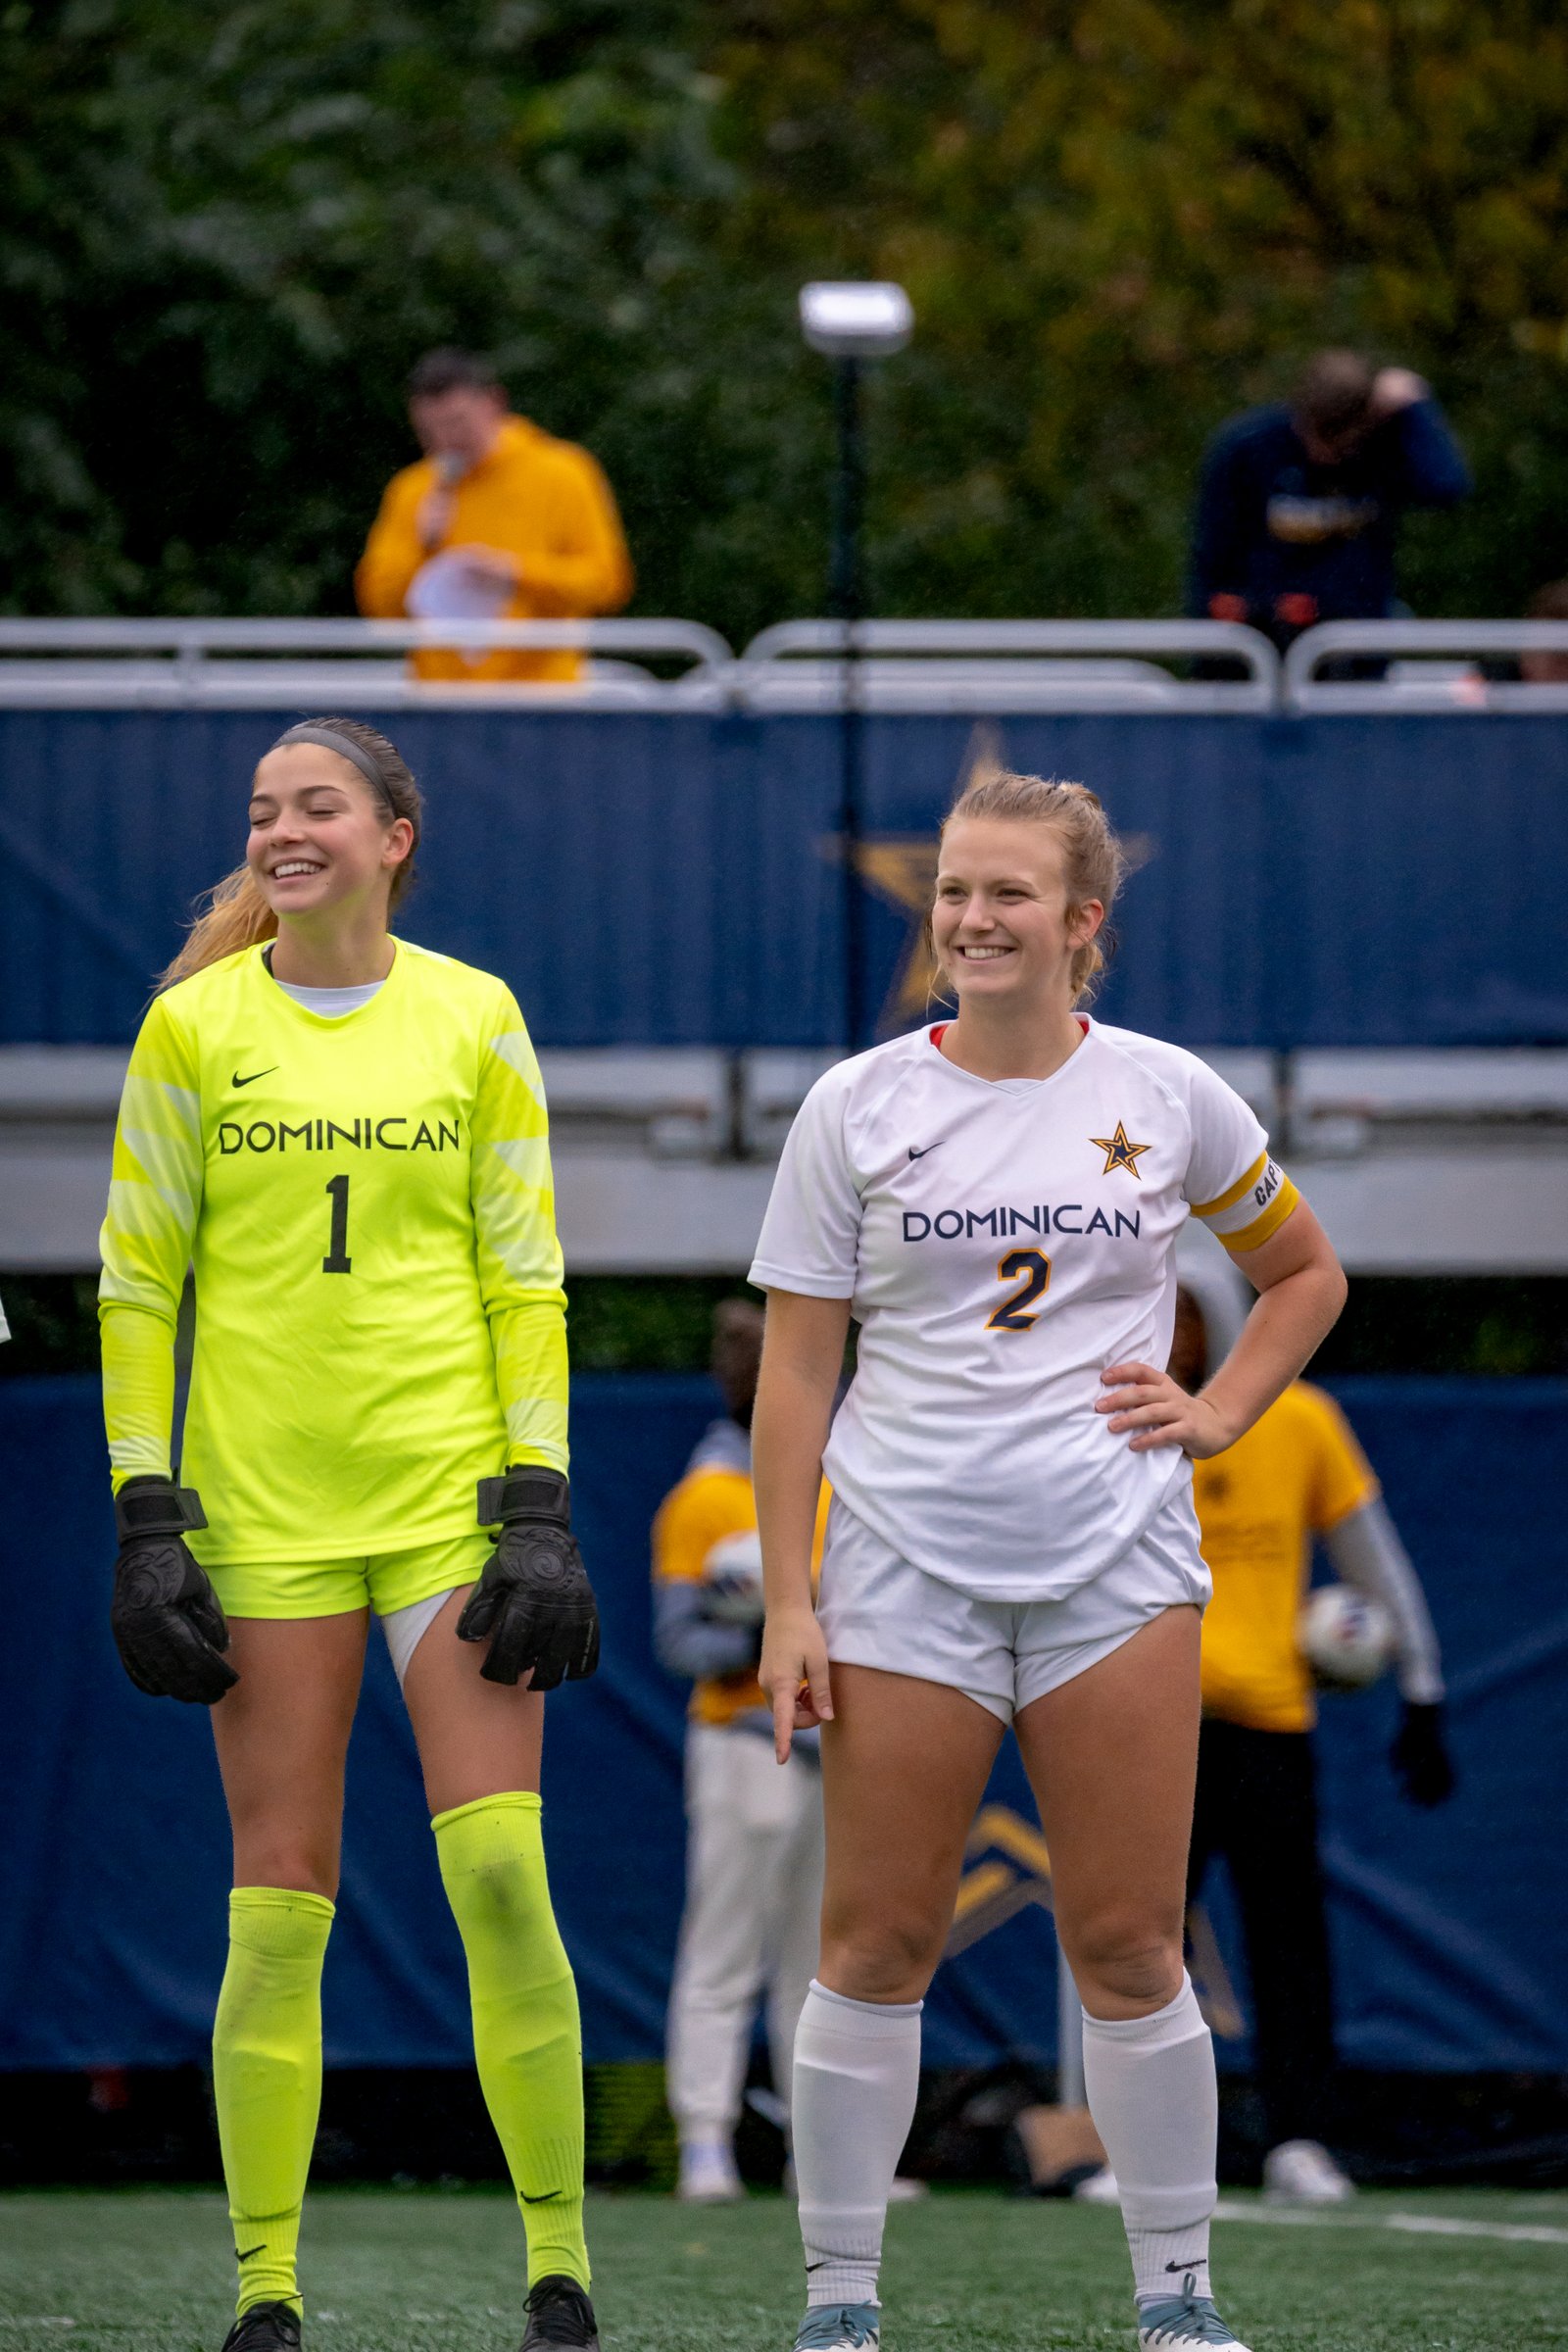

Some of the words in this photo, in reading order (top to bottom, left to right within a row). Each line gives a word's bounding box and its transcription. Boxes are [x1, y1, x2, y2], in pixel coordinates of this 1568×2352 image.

[219, 1117, 460, 1154] DOMINICAN
[322, 1174, 352, 1274] 1
[903, 1204, 1140, 1242] DOMINICAN
[983, 1247, 1053, 1333] 2
